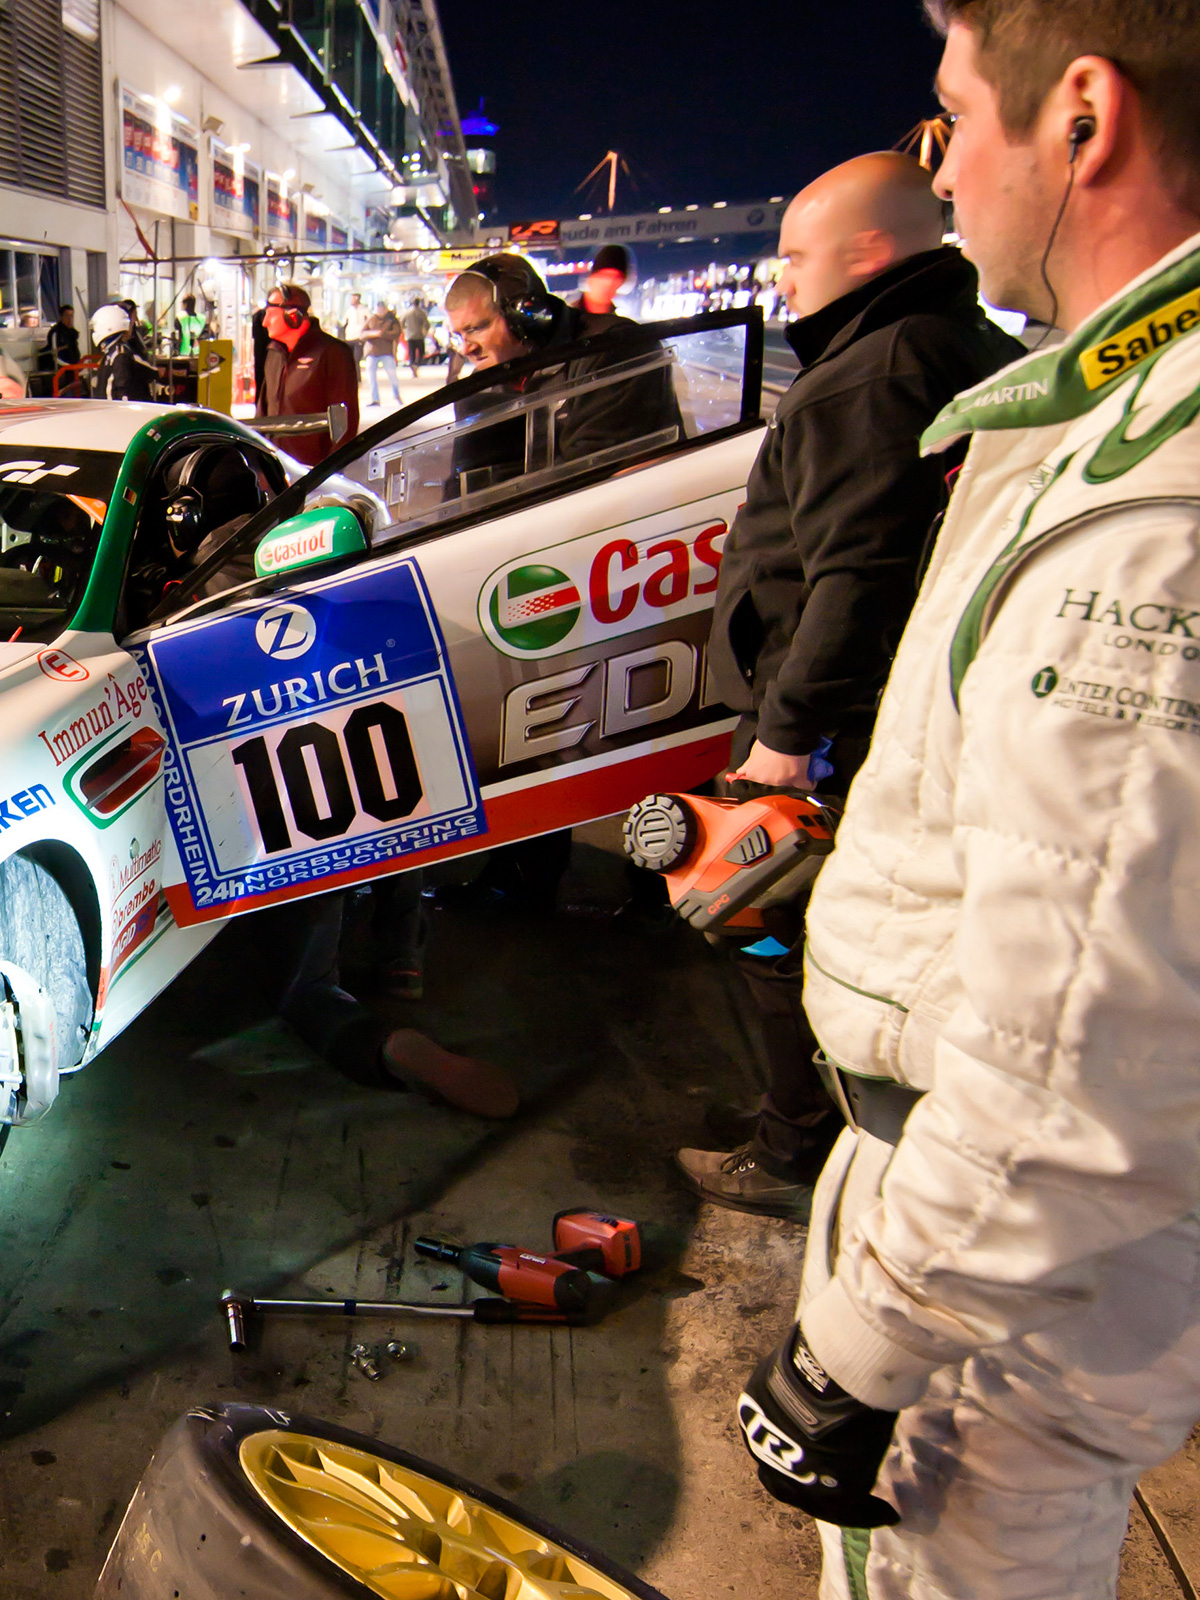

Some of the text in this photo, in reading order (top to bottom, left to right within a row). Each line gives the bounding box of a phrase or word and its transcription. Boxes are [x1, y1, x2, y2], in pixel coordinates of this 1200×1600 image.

[1097, 298, 1200, 377] Sabe
[972, 378, 1049, 408] MARTIN
[274, 529, 326, 563] Castrol
[588, 520, 738, 624] Cas
[222, 653, 389, 728] ZURICH
[499, 638, 715, 768] ED
[231, 701, 424, 854] 100
[119, 839, 162, 887] Multimatic
[244, 814, 478, 884] NÜRBURGRING
[248, 824, 480, 894] NORDSCHLEIFE
[117, 878, 156, 929] brembo
[196, 879, 245, 907] 24h
